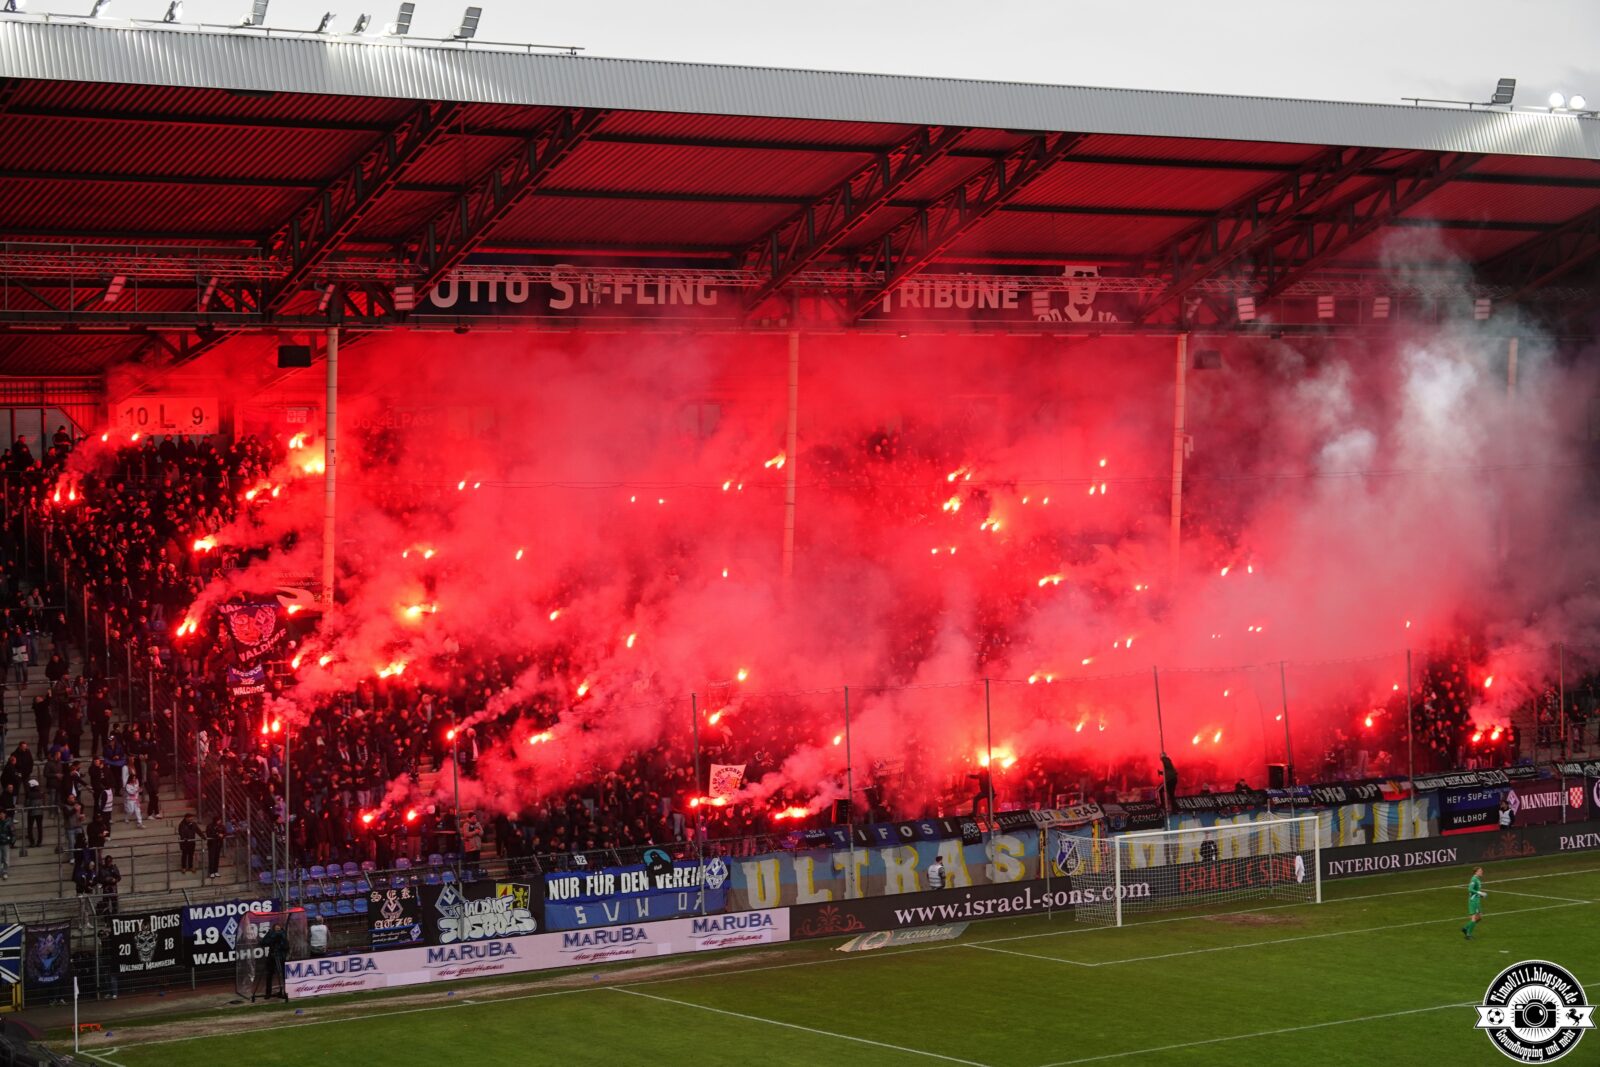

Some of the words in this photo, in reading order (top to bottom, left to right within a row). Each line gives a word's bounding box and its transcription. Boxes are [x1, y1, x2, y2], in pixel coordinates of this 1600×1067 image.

[430, 268, 529, 308] OTTO
[549, 264, 717, 309] SIFFLING
[125, 407, 148, 426] 10
[160, 404, 176, 428] L
[192, 406, 204, 425] 9
[1520, 791, 1569, 811] MANNHEIM
[1453, 812, 1487, 825] WALDHOF
[834, 821, 954, 843] TIFOSI
[575, 856, 585, 864] 12
[1260, 856, 1297, 884] SON
[1328, 854, 1401, 875] INTERIOR
[1405, 848, 1458, 866] DESIGN
[741, 835, 1024, 911] ULTRAS
[548, 876, 580, 900] NUR
[585, 871, 615, 897] FÜR
[620, 870, 649, 894] DEN
[189, 900, 273, 921] MADDOGS
[895, 881, 1151, 925] www.israel-sons.com
[112, 918, 144, 936] DIRTY
[150, 913, 180, 931] DICKS
[119, 943, 131, 956] 20
[164, 937, 174, 951] 18
[193, 926, 220, 946] 19
[119, 963, 144, 973] WALDHOF
[145, 958, 176, 970] MANNHEIM
